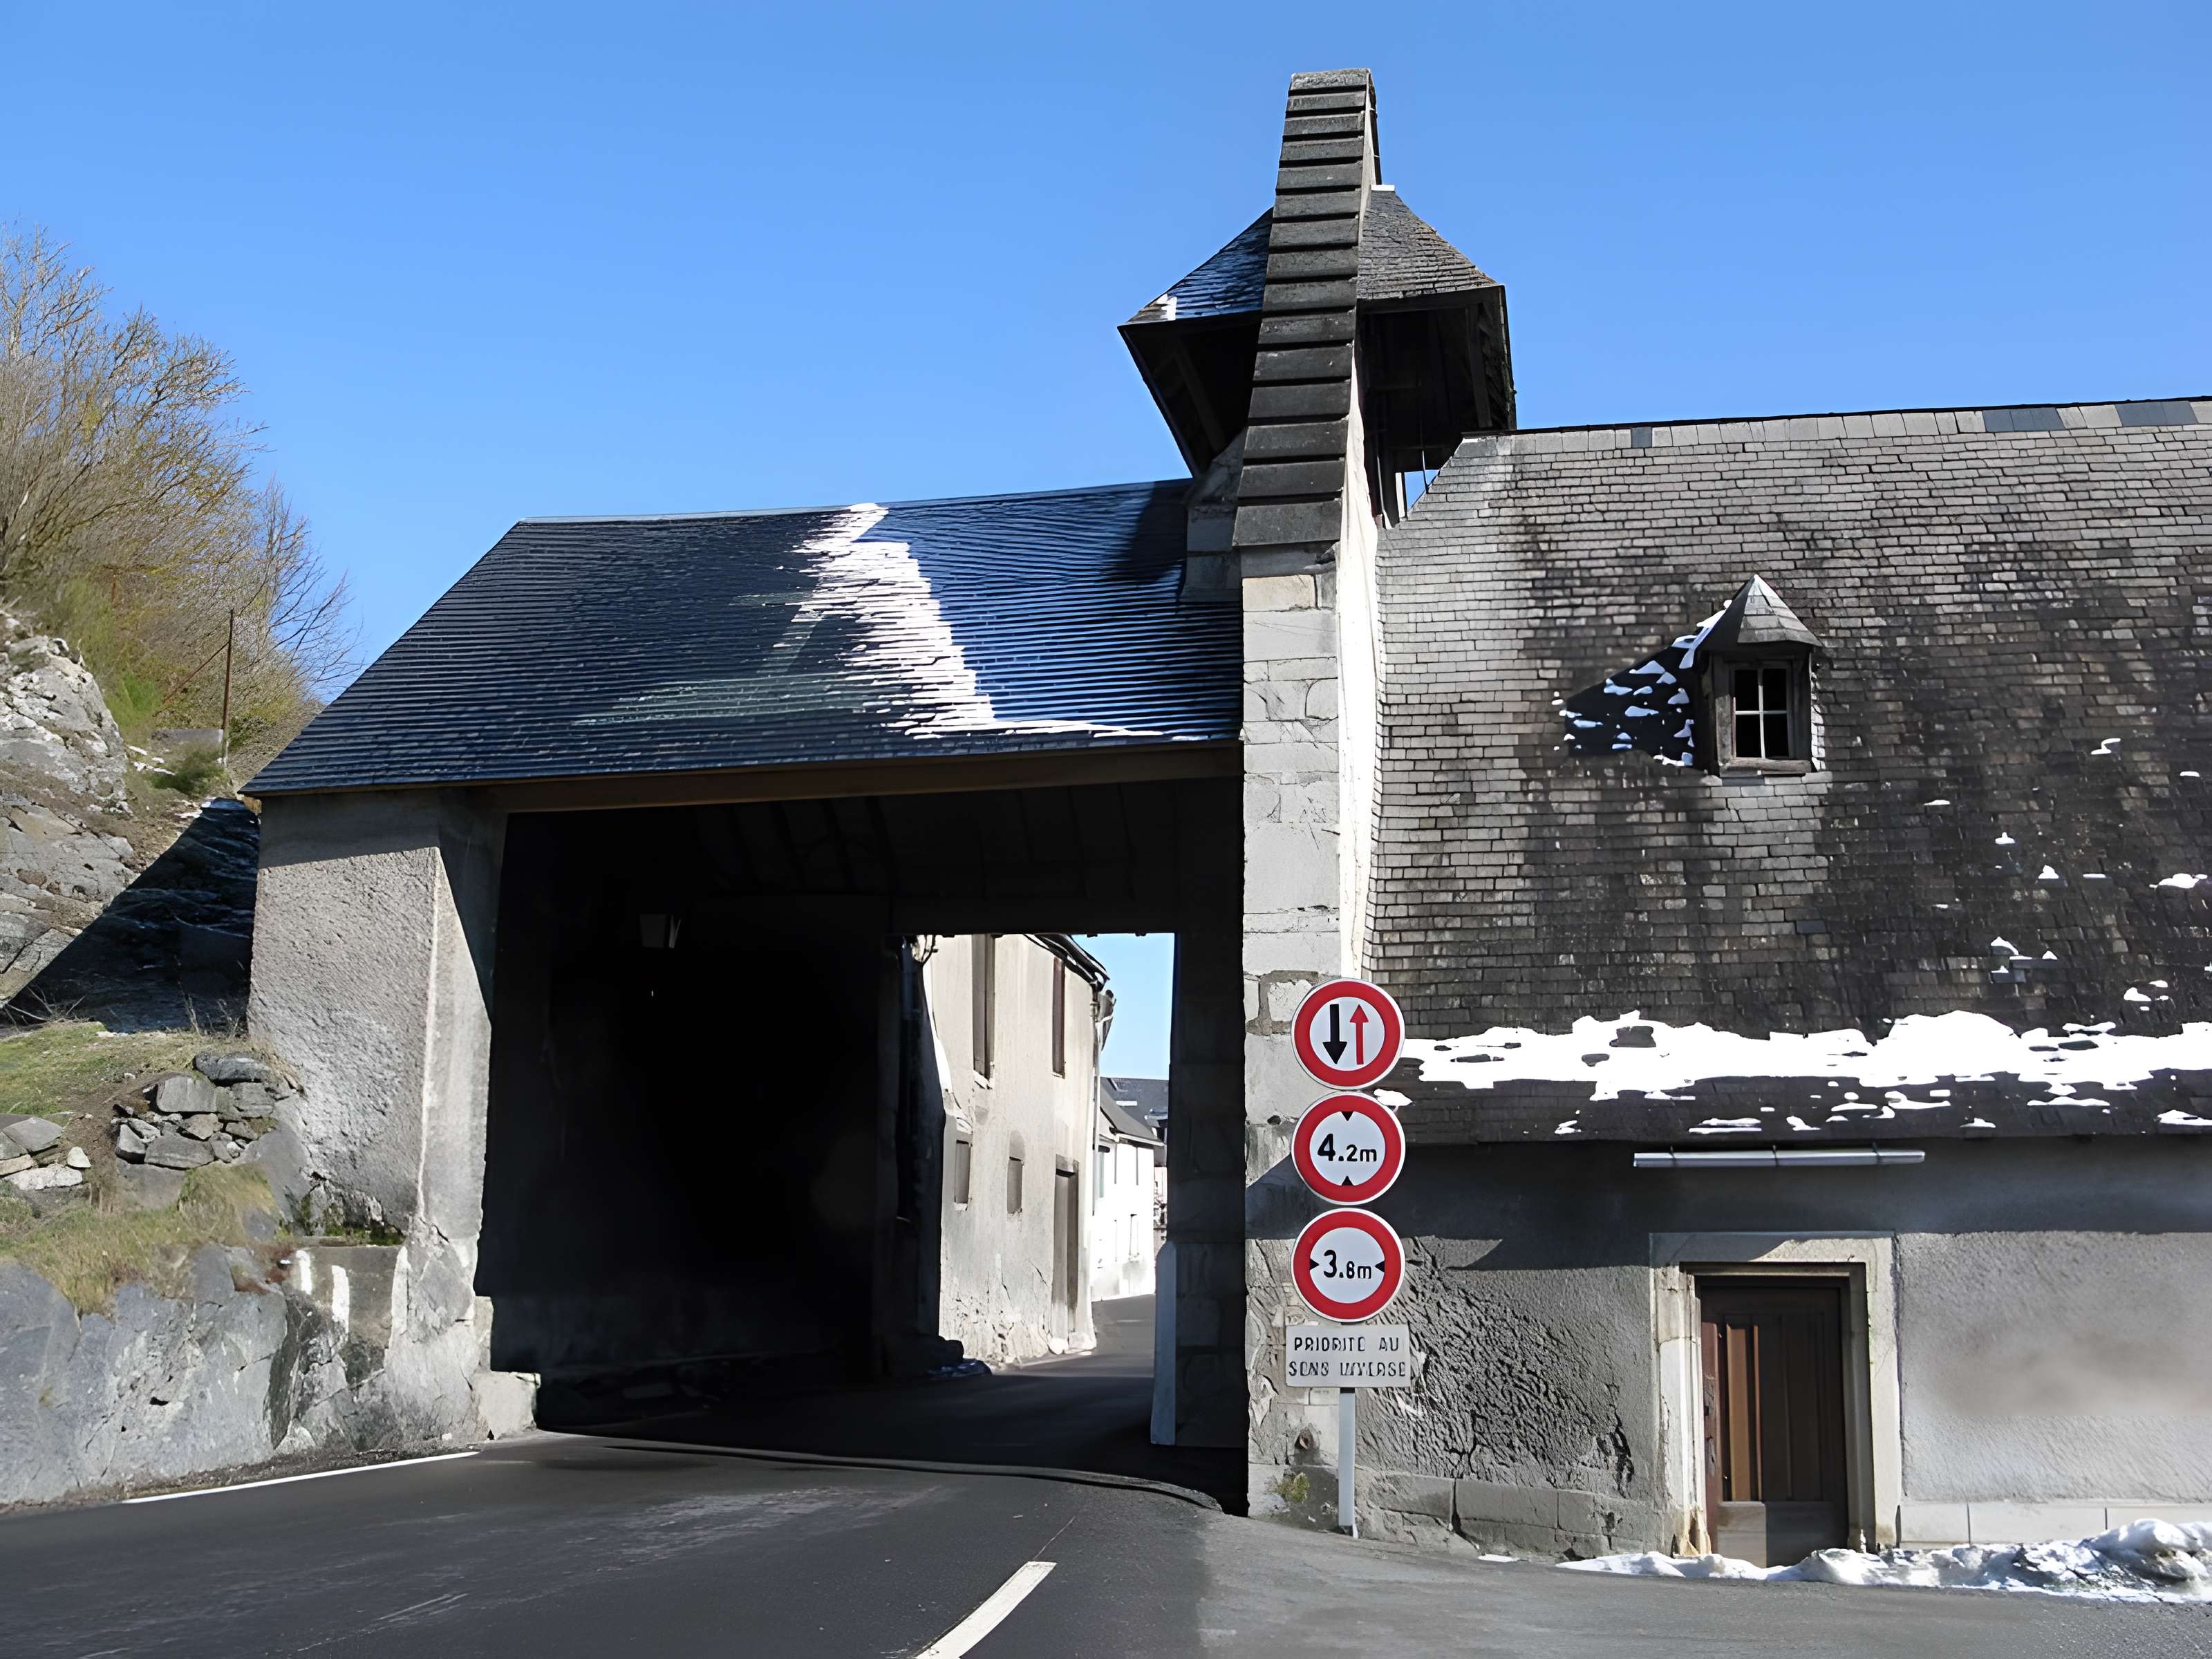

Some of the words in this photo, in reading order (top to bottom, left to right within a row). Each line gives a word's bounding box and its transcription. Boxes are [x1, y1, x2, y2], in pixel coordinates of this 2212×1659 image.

[1317, 1133, 1377, 1162] 4.2m
[1378, 1336, 1399, 1352] AU
[1288, 1360, 1329, 1377] SENS
